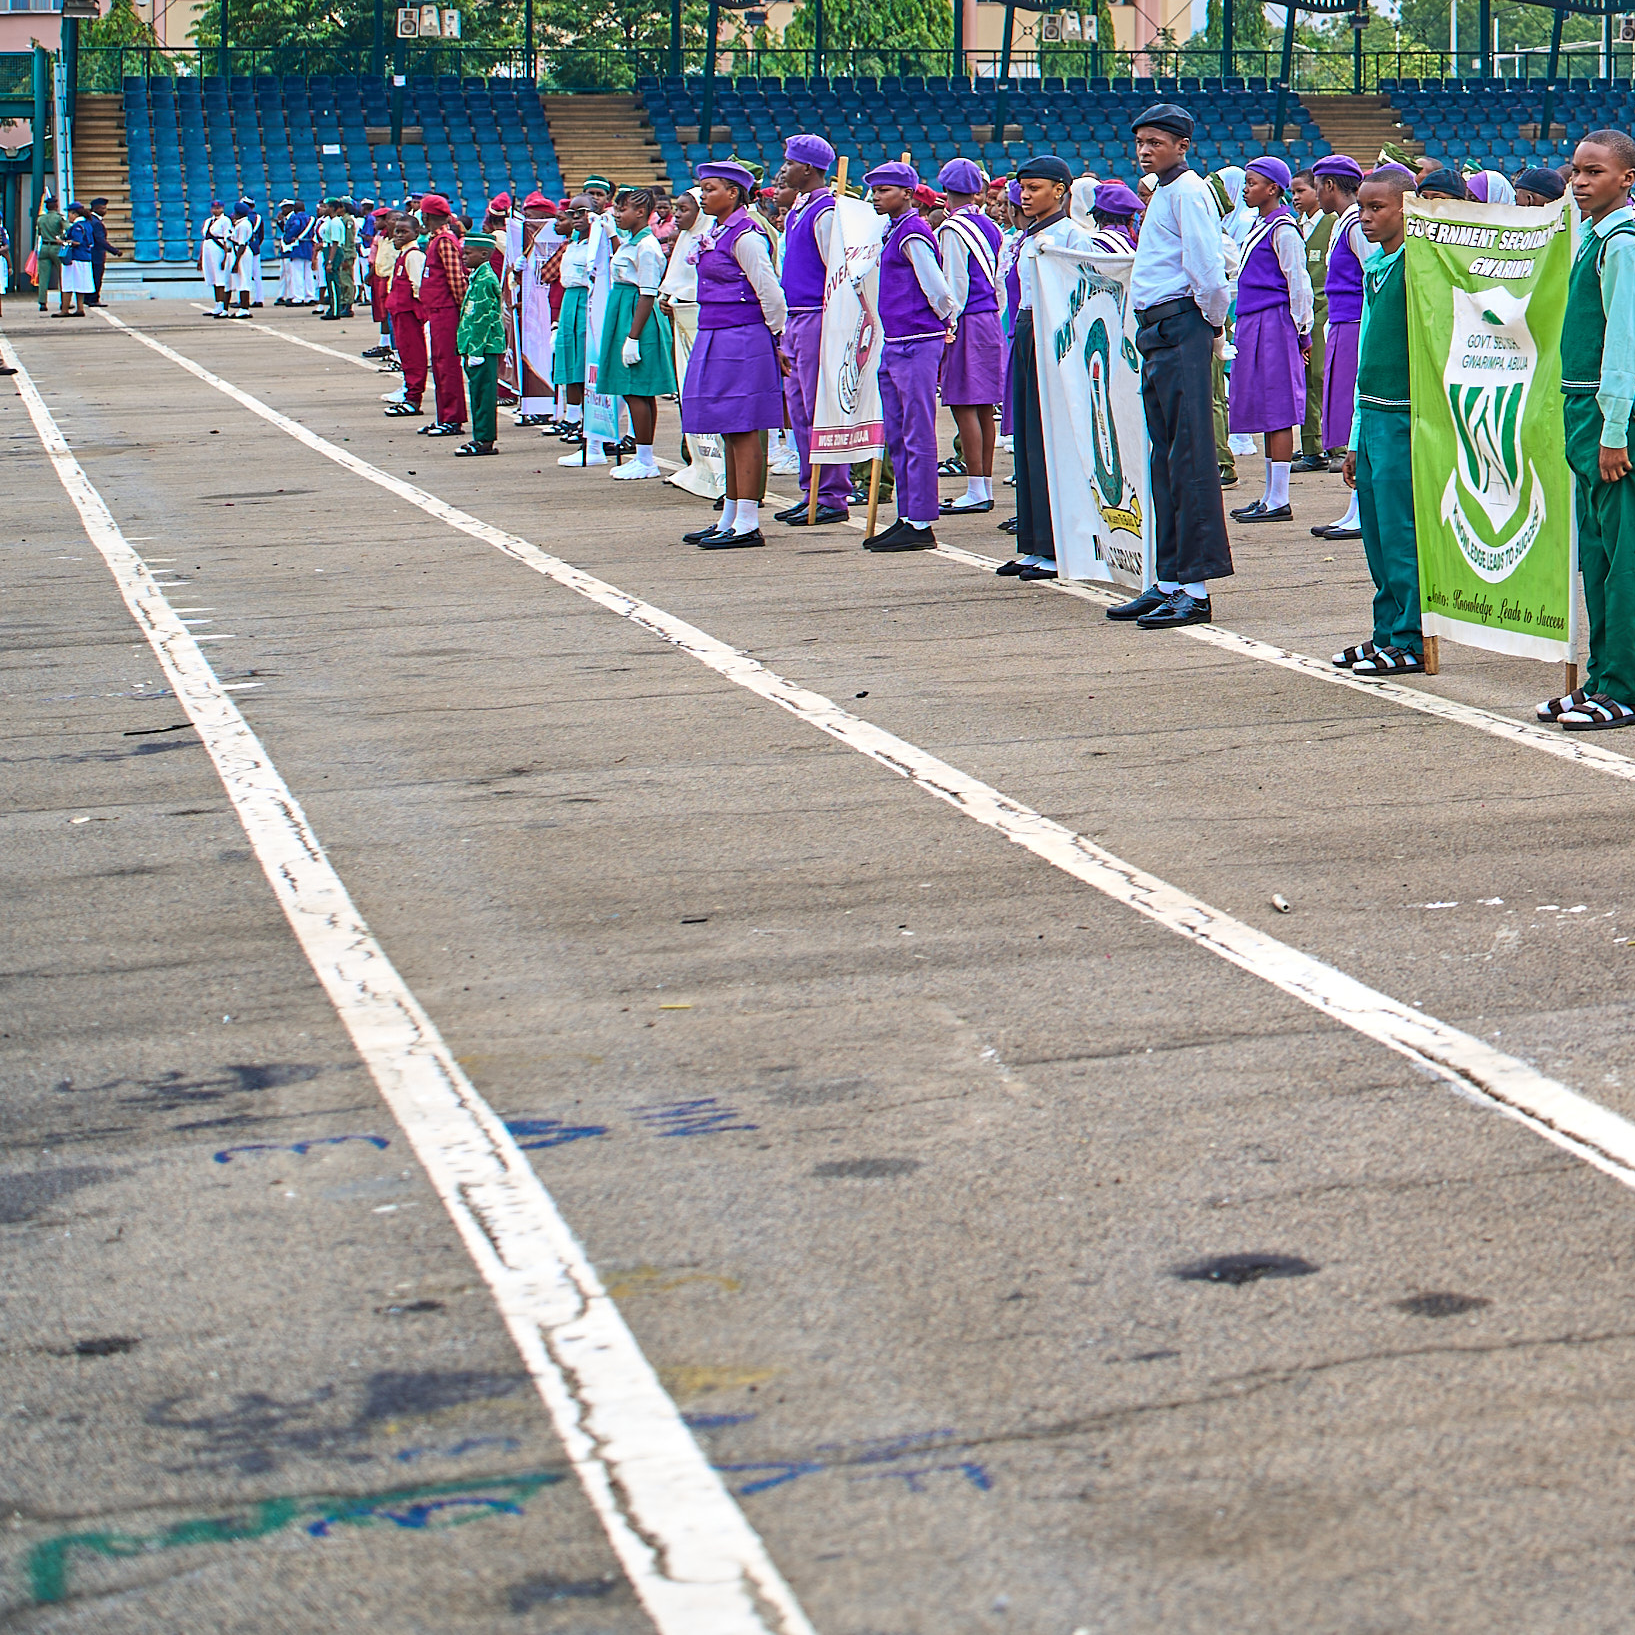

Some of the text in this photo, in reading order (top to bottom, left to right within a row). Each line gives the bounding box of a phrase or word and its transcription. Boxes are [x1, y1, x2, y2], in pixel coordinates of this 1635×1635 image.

[1453, 502, 1486, 568] KNOWLEDGE
[1487, 550, 1503, 571] LEADS
[1505, 547, 1514, 565] TO
[1453, 589, 1565, 630] Knowledge Leads to Success
